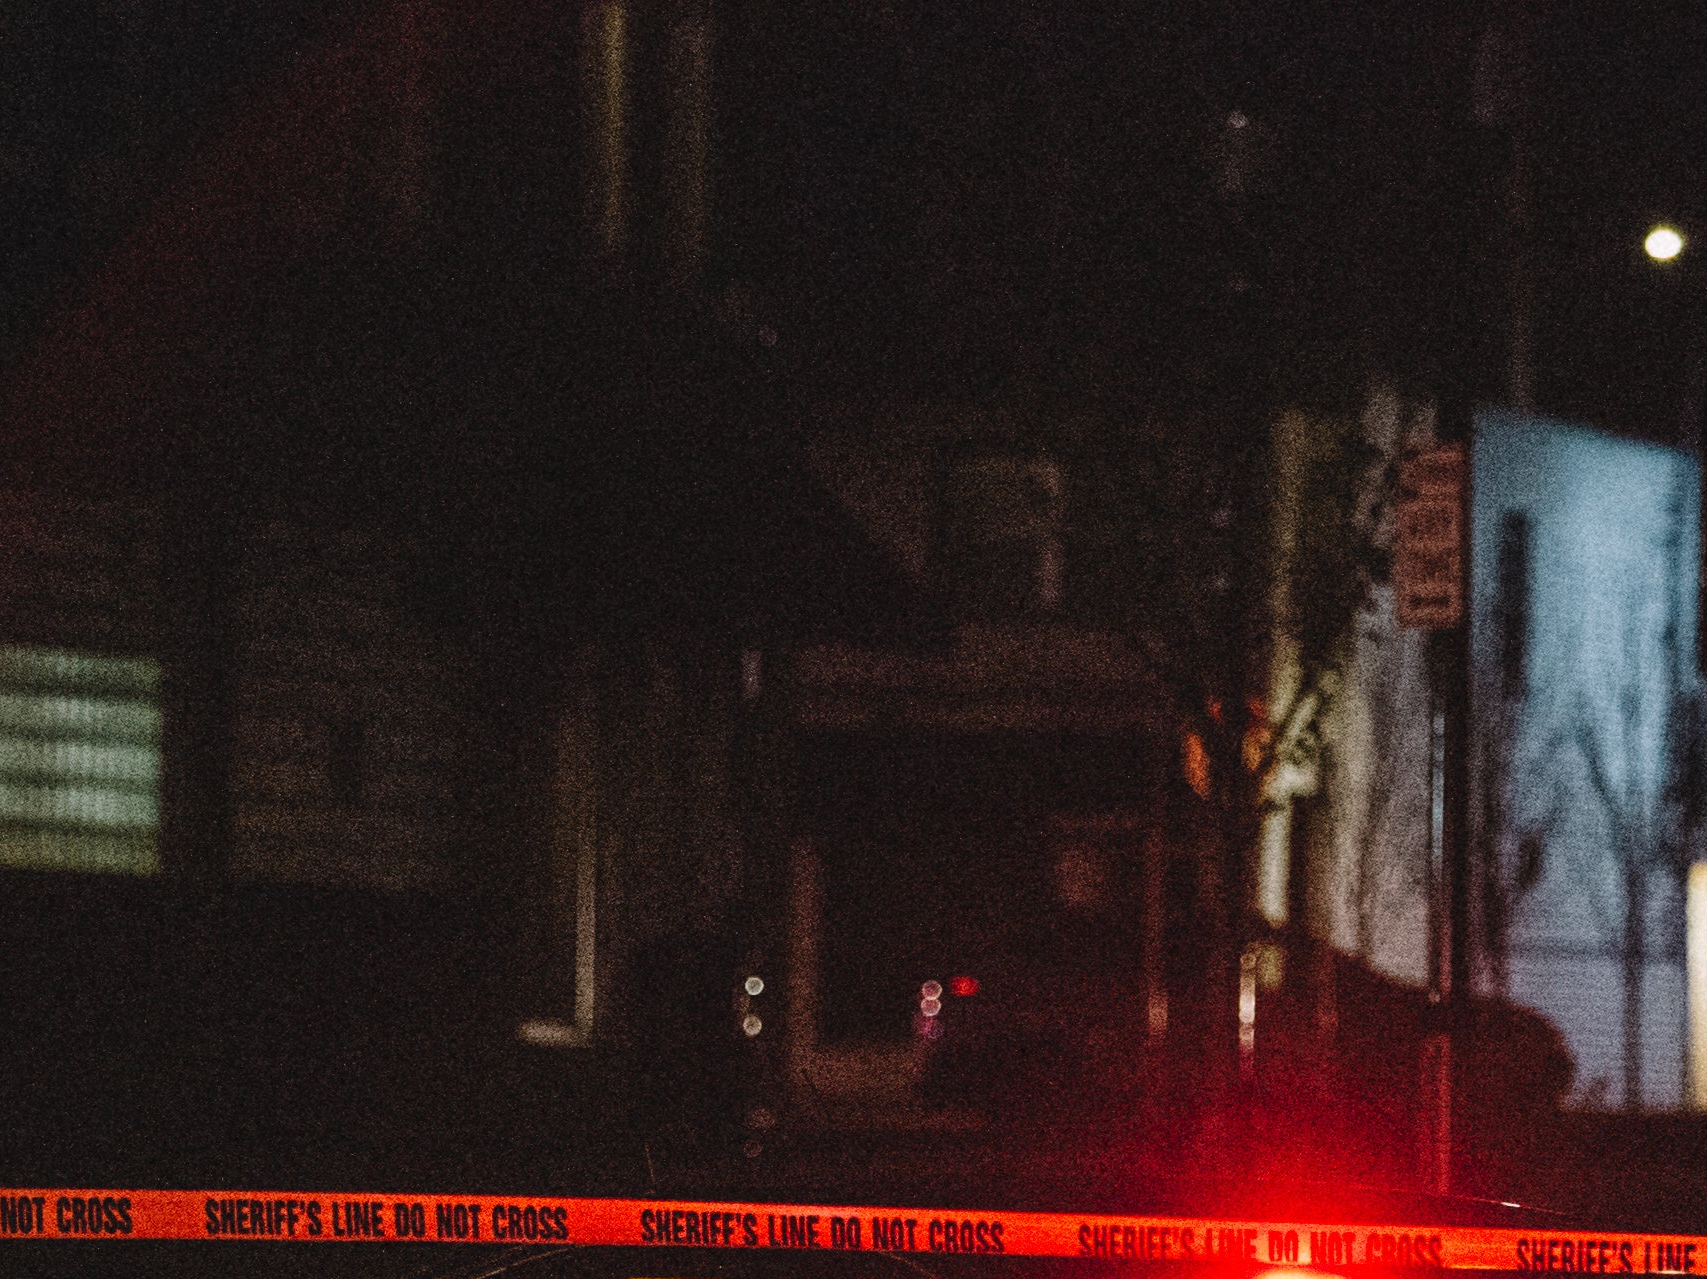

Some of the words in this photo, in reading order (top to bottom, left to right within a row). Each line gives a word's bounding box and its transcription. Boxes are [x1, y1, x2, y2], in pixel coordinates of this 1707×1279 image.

[55, 1196, 133, 1235] CROSS
[204, 1199, 323, 1236] SHERIFF'S
[331, 1201, 384, 1237] LINE
[393, 1202, 427, 1238] DO
[435, 1203, 481, 1239] NOT
[491, 1204, 569, 1240] CROSS
[640, 1209, 758, 1247] SHERIFF'S
[767, 1212, 819, 1249] LINE
[830, 1215, 862, 1250] DO
[871, 1217, 916, 1252] NOT
[928, 1219, 1004, 1254] CROSS
[1077, 1224, 1194, 1261] SHERIFF'S
[1267, 1229, 1300, 1263] DO
[1309, 1230, 1356, 1265] NOT
[1365, 1232, 1443, 1268] CROSS
[1515, 1238, 1632, 1275] SHERIFF'S
